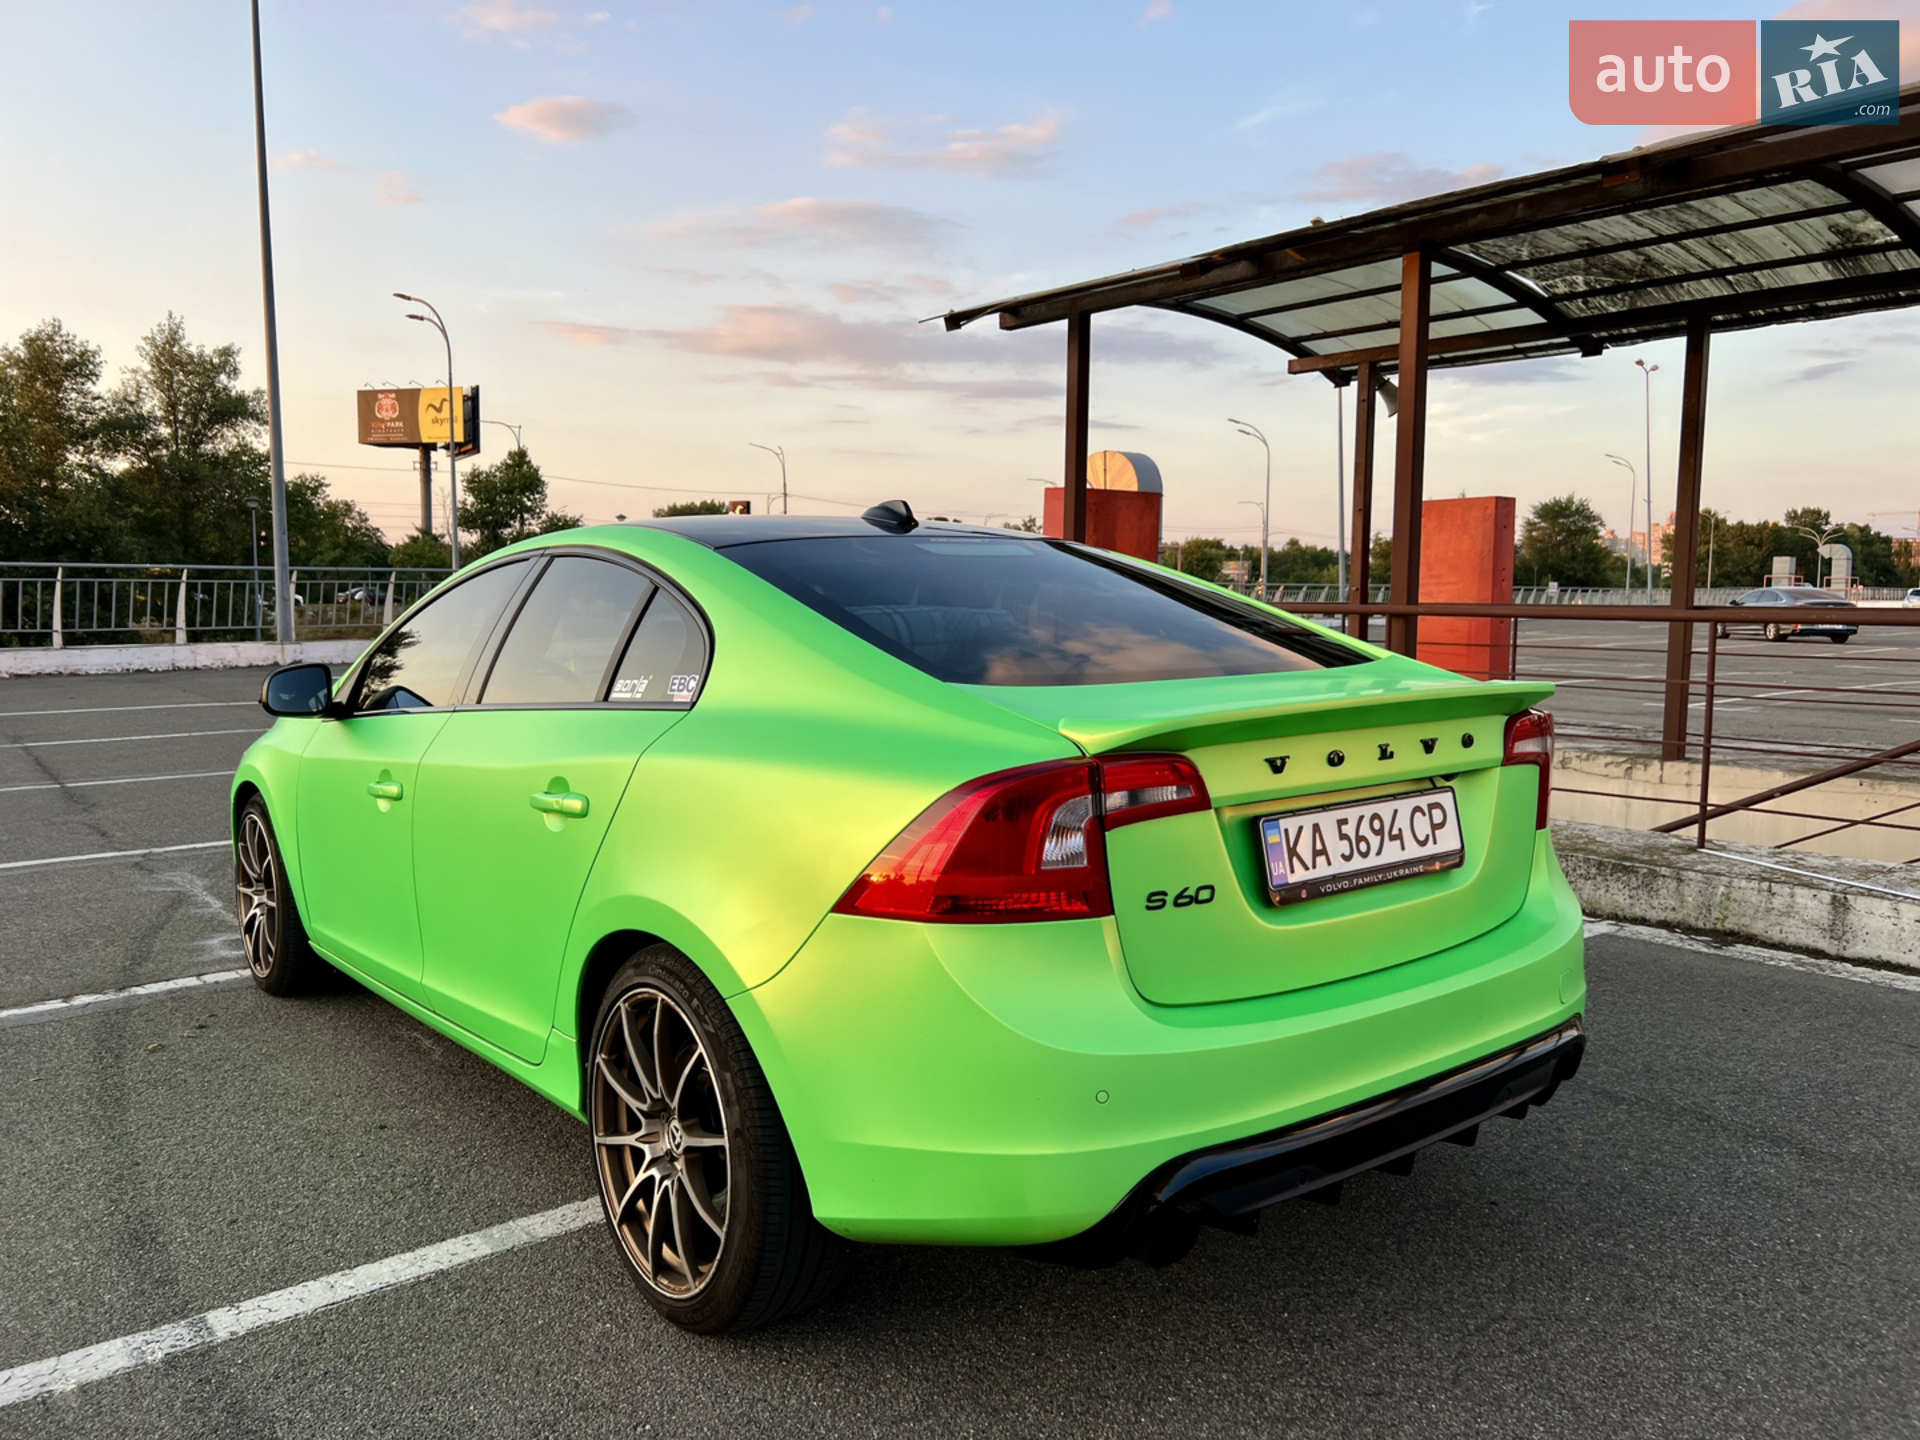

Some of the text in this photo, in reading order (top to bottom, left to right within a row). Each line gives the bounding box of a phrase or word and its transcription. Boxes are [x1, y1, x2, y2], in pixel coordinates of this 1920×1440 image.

[669, 676, 697, 693] EBC
[1264, 732, 1475, 775] VOLVO
[1283, 801, 1448, 875] KA 5694 CP
[1271, 861, 1286, 876] UA
